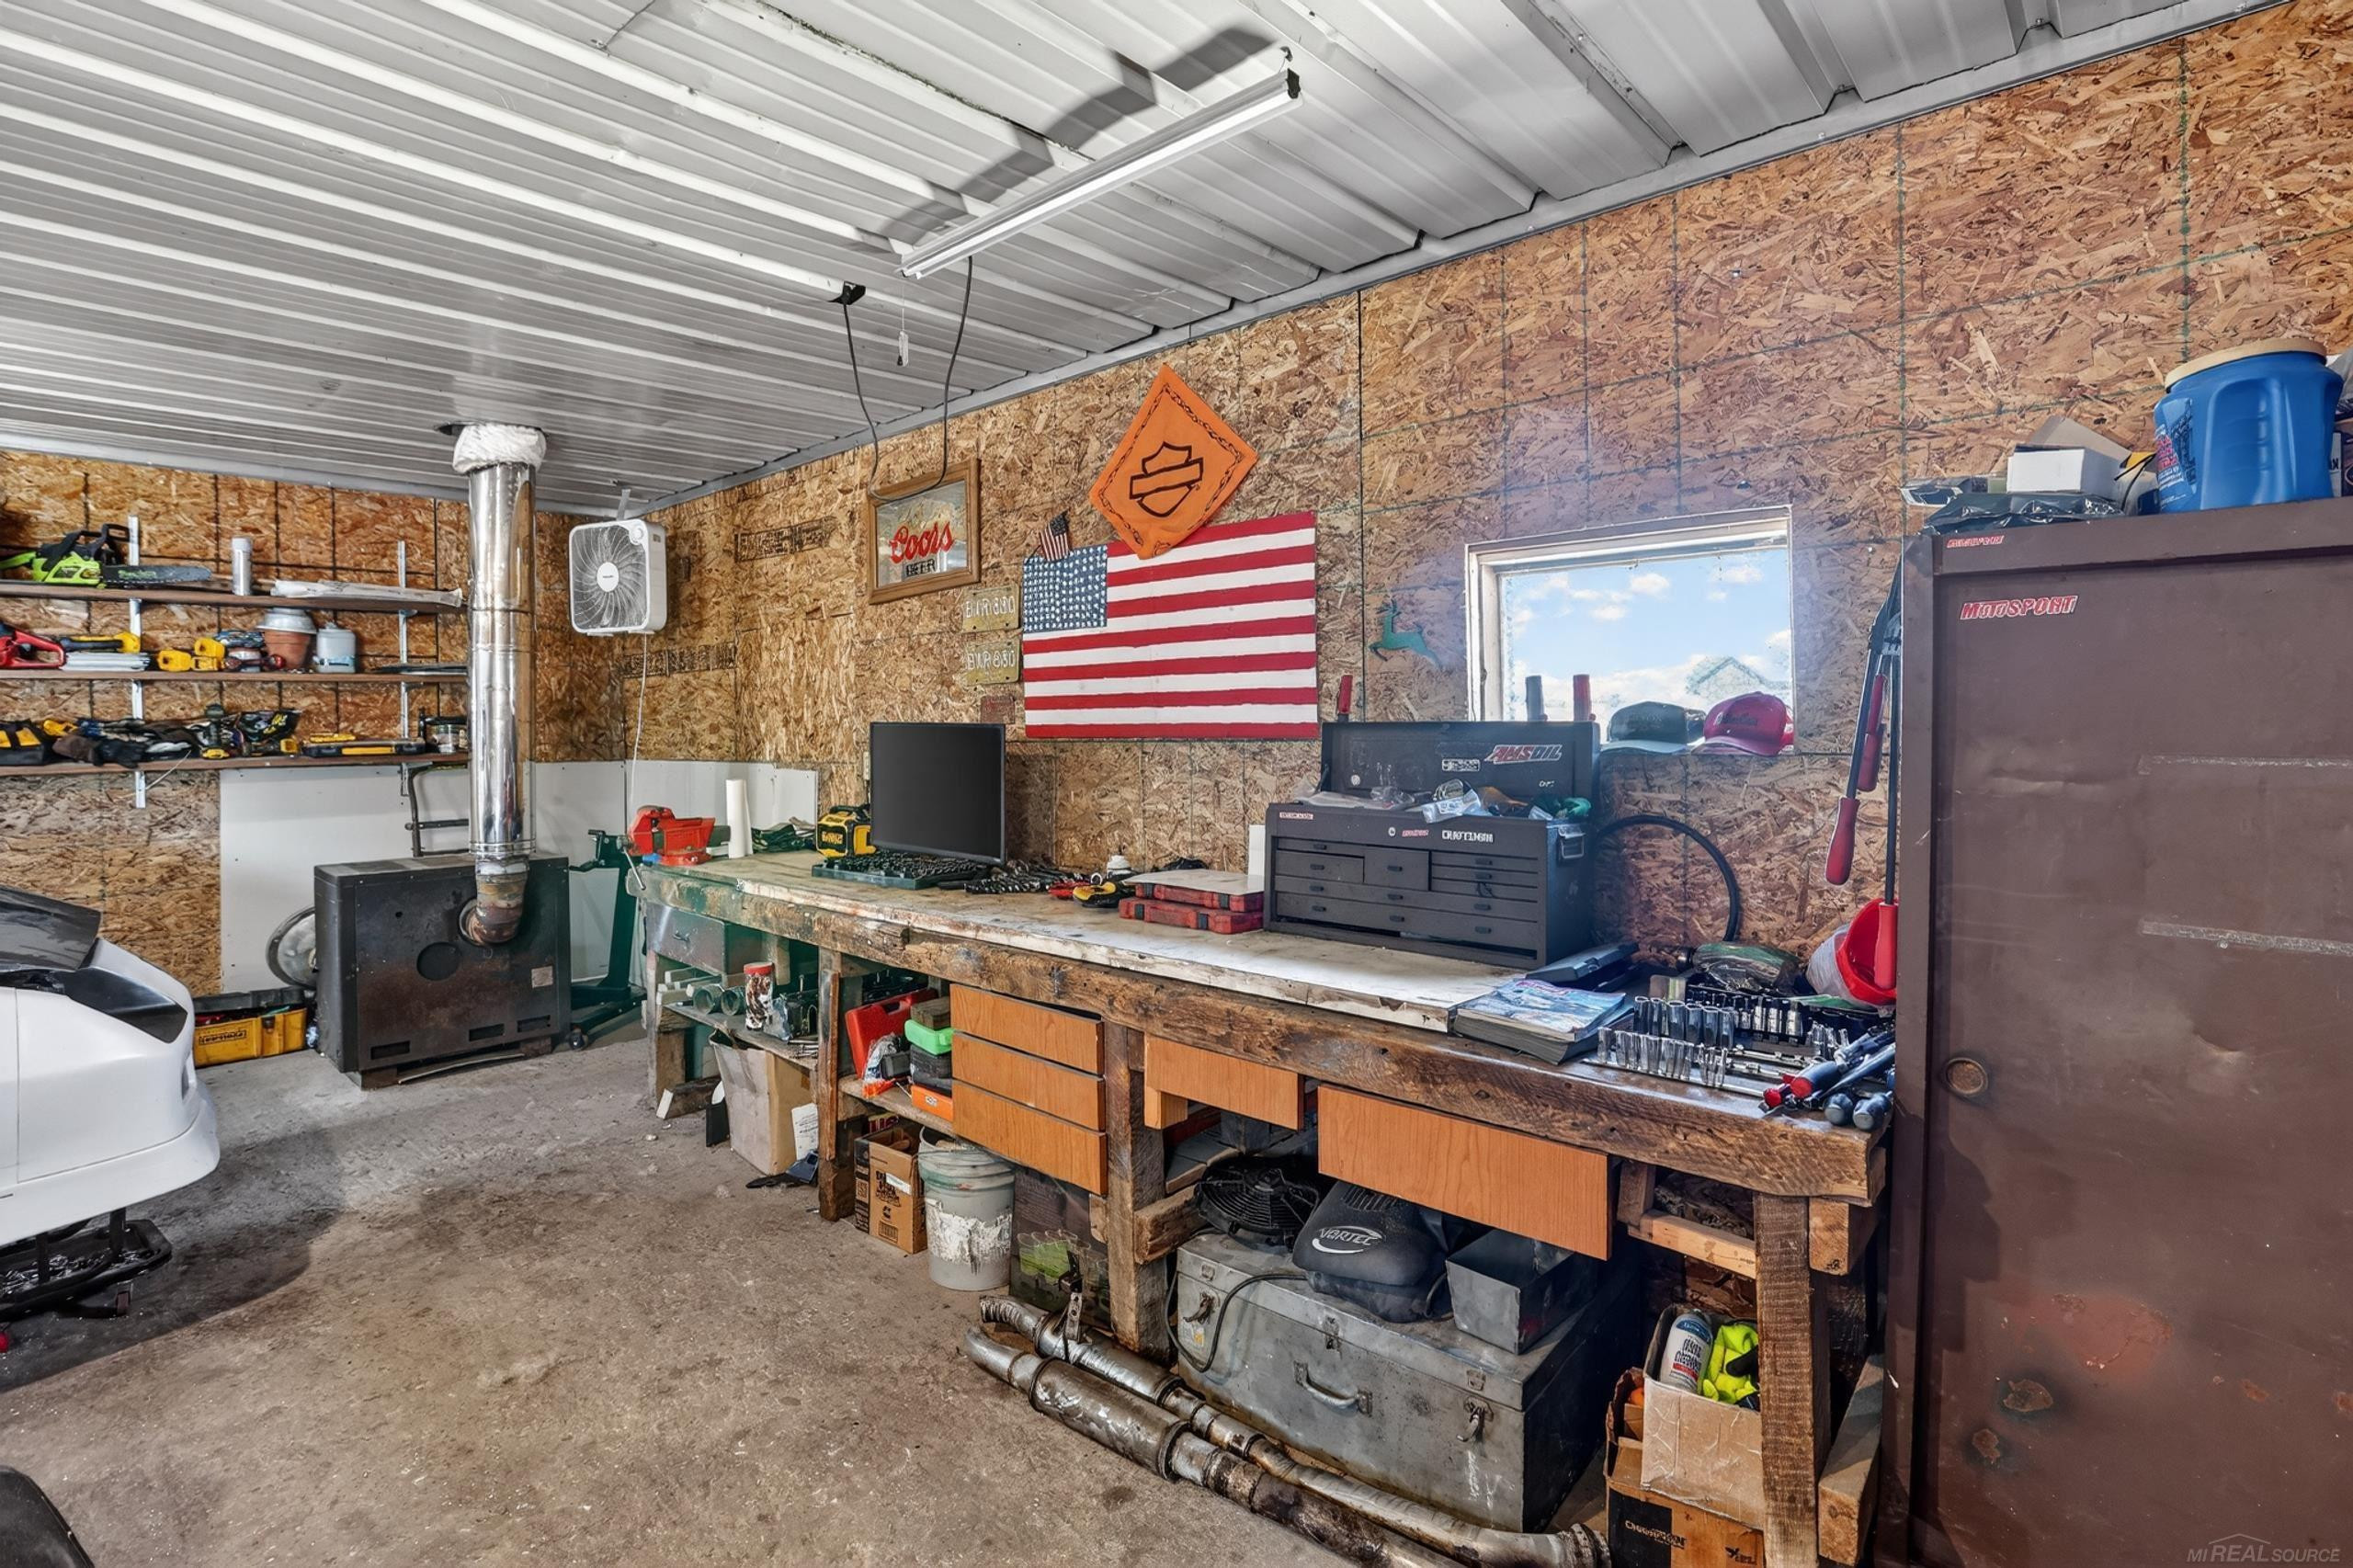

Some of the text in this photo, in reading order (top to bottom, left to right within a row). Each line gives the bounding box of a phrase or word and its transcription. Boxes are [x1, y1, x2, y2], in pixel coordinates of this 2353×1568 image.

[889, 521, 955, 563] Coors
[1961, 595, 2078, 620] MOTOSPORT
[1484, 744, 1563, 765] AMSOIL
